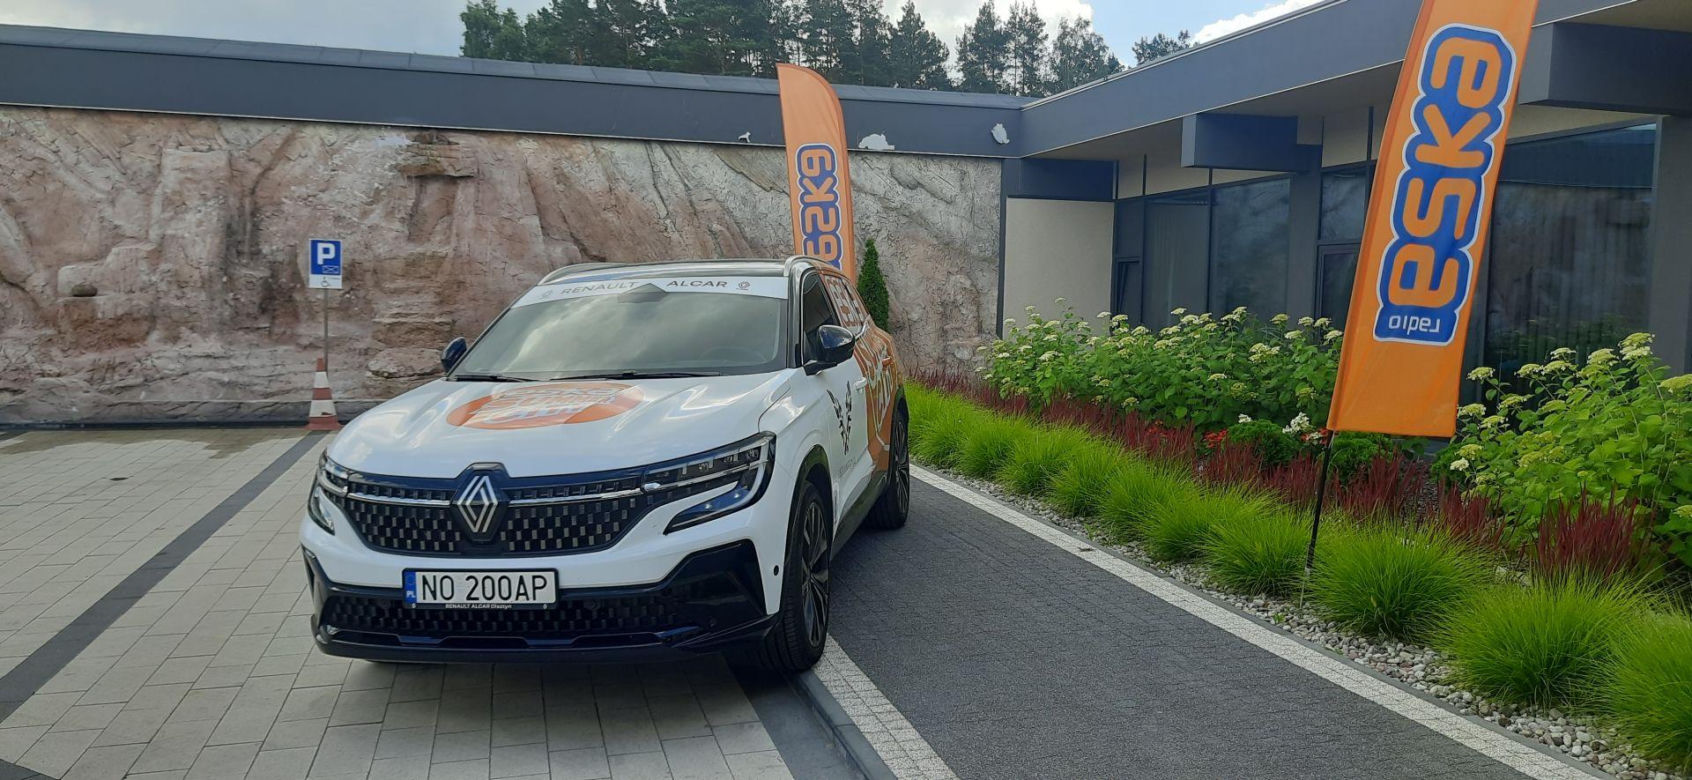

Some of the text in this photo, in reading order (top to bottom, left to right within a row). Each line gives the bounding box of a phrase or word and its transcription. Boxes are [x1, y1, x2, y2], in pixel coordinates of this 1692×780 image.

[1387, 36, 1502, 308] eska
[317, 242, 336, 265] P
[560, 280, 728, 295] RENAULT ALCAR
[1388, 315, 1441, 335] radio
[406, 590, 416, 598] PL
[422, 574, 548, 602] NO 200AP
